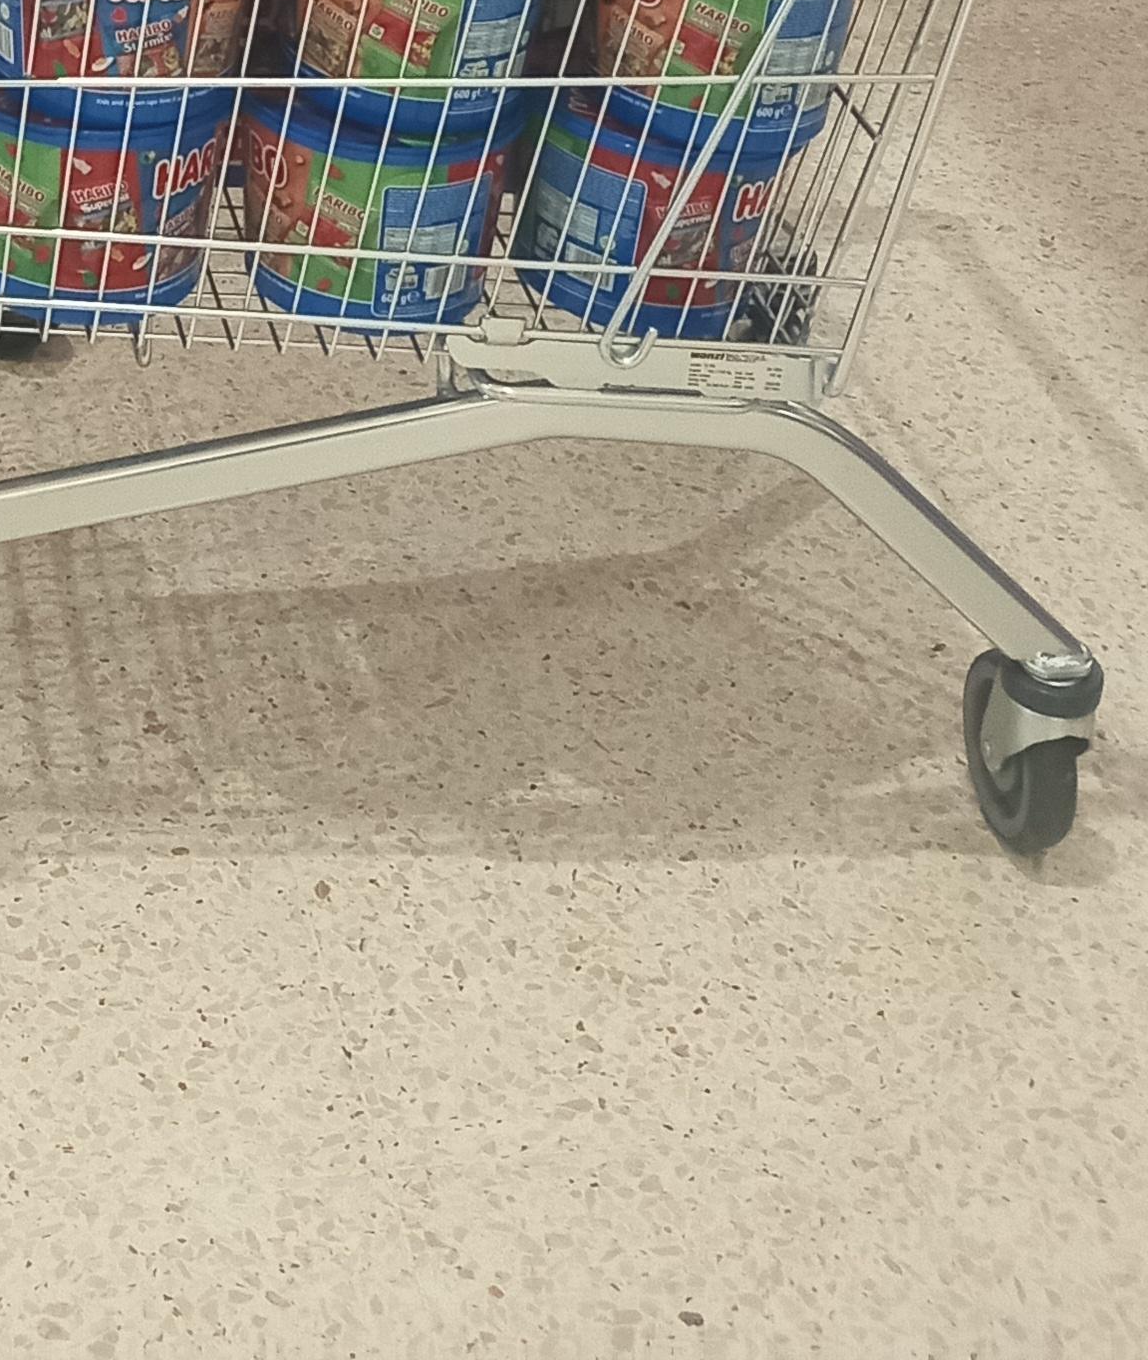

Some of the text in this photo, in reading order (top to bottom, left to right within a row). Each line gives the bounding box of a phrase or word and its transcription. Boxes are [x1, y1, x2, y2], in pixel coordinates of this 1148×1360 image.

[694, 0, 751, 34] HARBO
[454, 89, 470, 100] 600
[756, 106, 774, 118] 600
